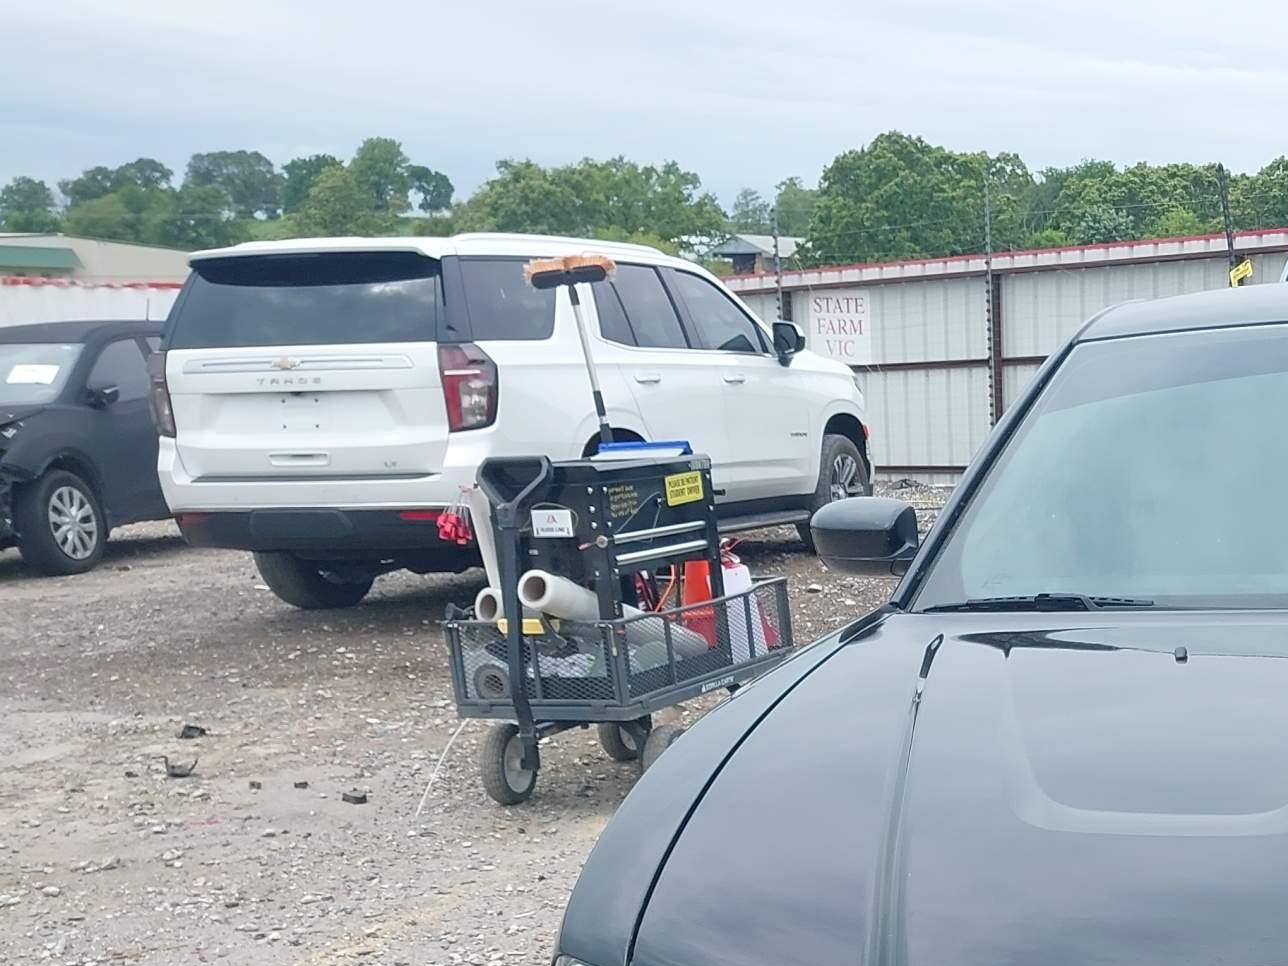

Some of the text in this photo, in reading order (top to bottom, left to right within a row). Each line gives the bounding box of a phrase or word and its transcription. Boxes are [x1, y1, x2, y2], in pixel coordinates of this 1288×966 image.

[814, 296, 865, 314] STATE
[817, 318, 864, 336] FARM
[826, 339, 855, 357] VIC
